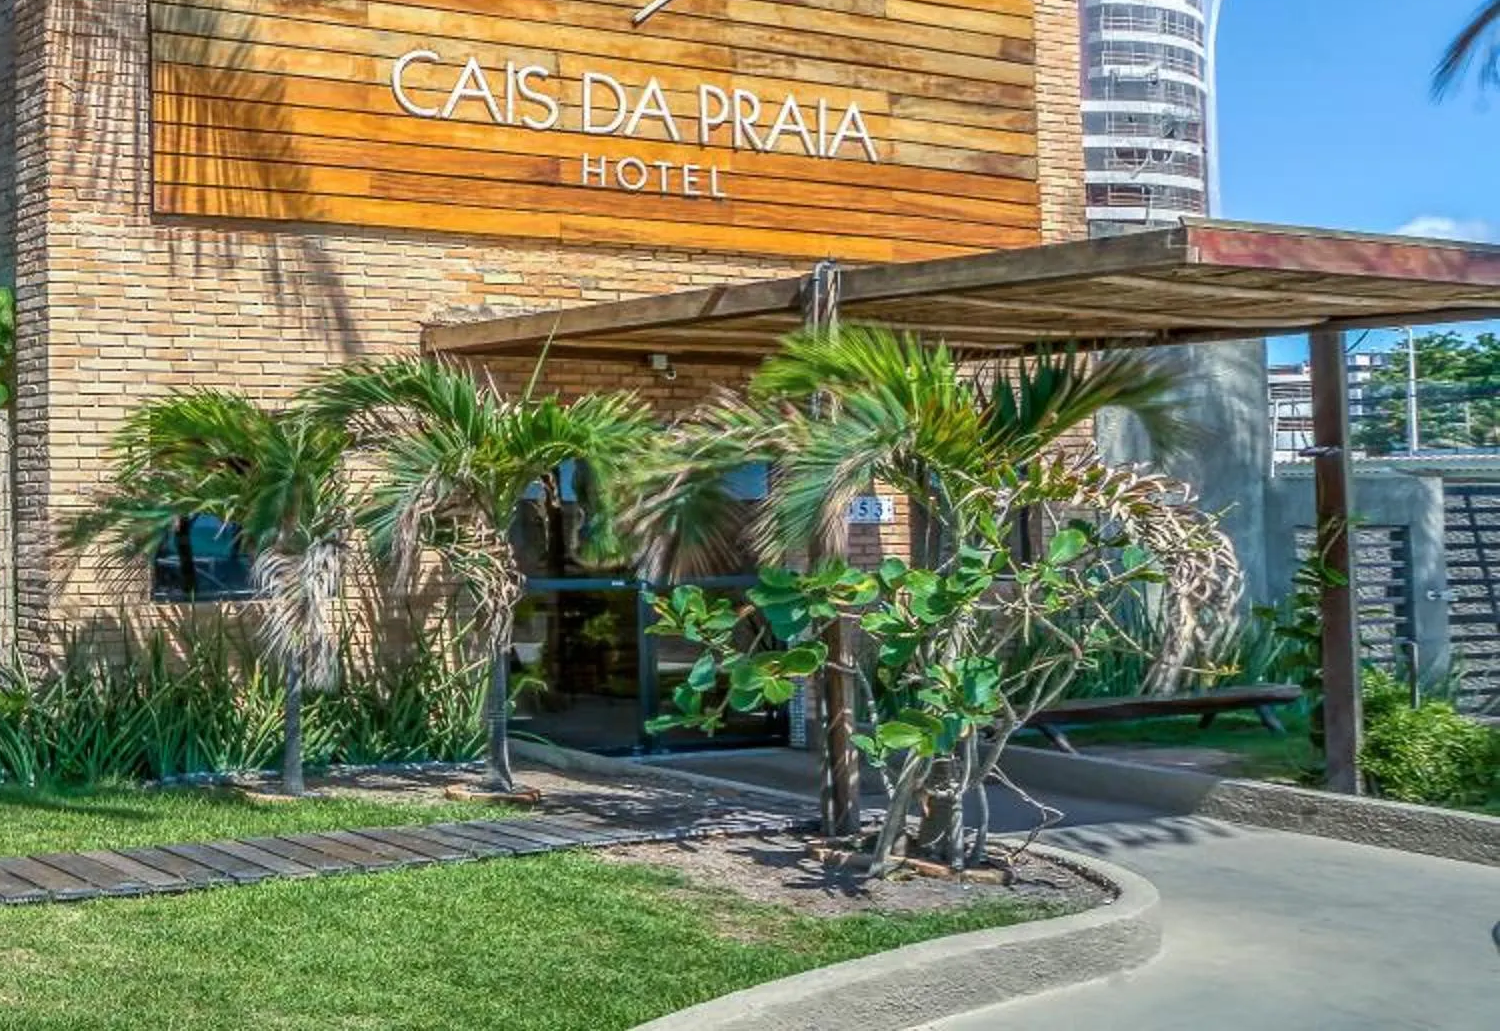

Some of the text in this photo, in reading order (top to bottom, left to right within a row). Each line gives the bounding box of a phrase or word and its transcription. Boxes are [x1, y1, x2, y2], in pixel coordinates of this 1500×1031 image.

[391, 50, 879, 163] CAIS DA PRAIA
[582, 154, 727, 198] HOTEL
[850, 501, 883, 518] 53
